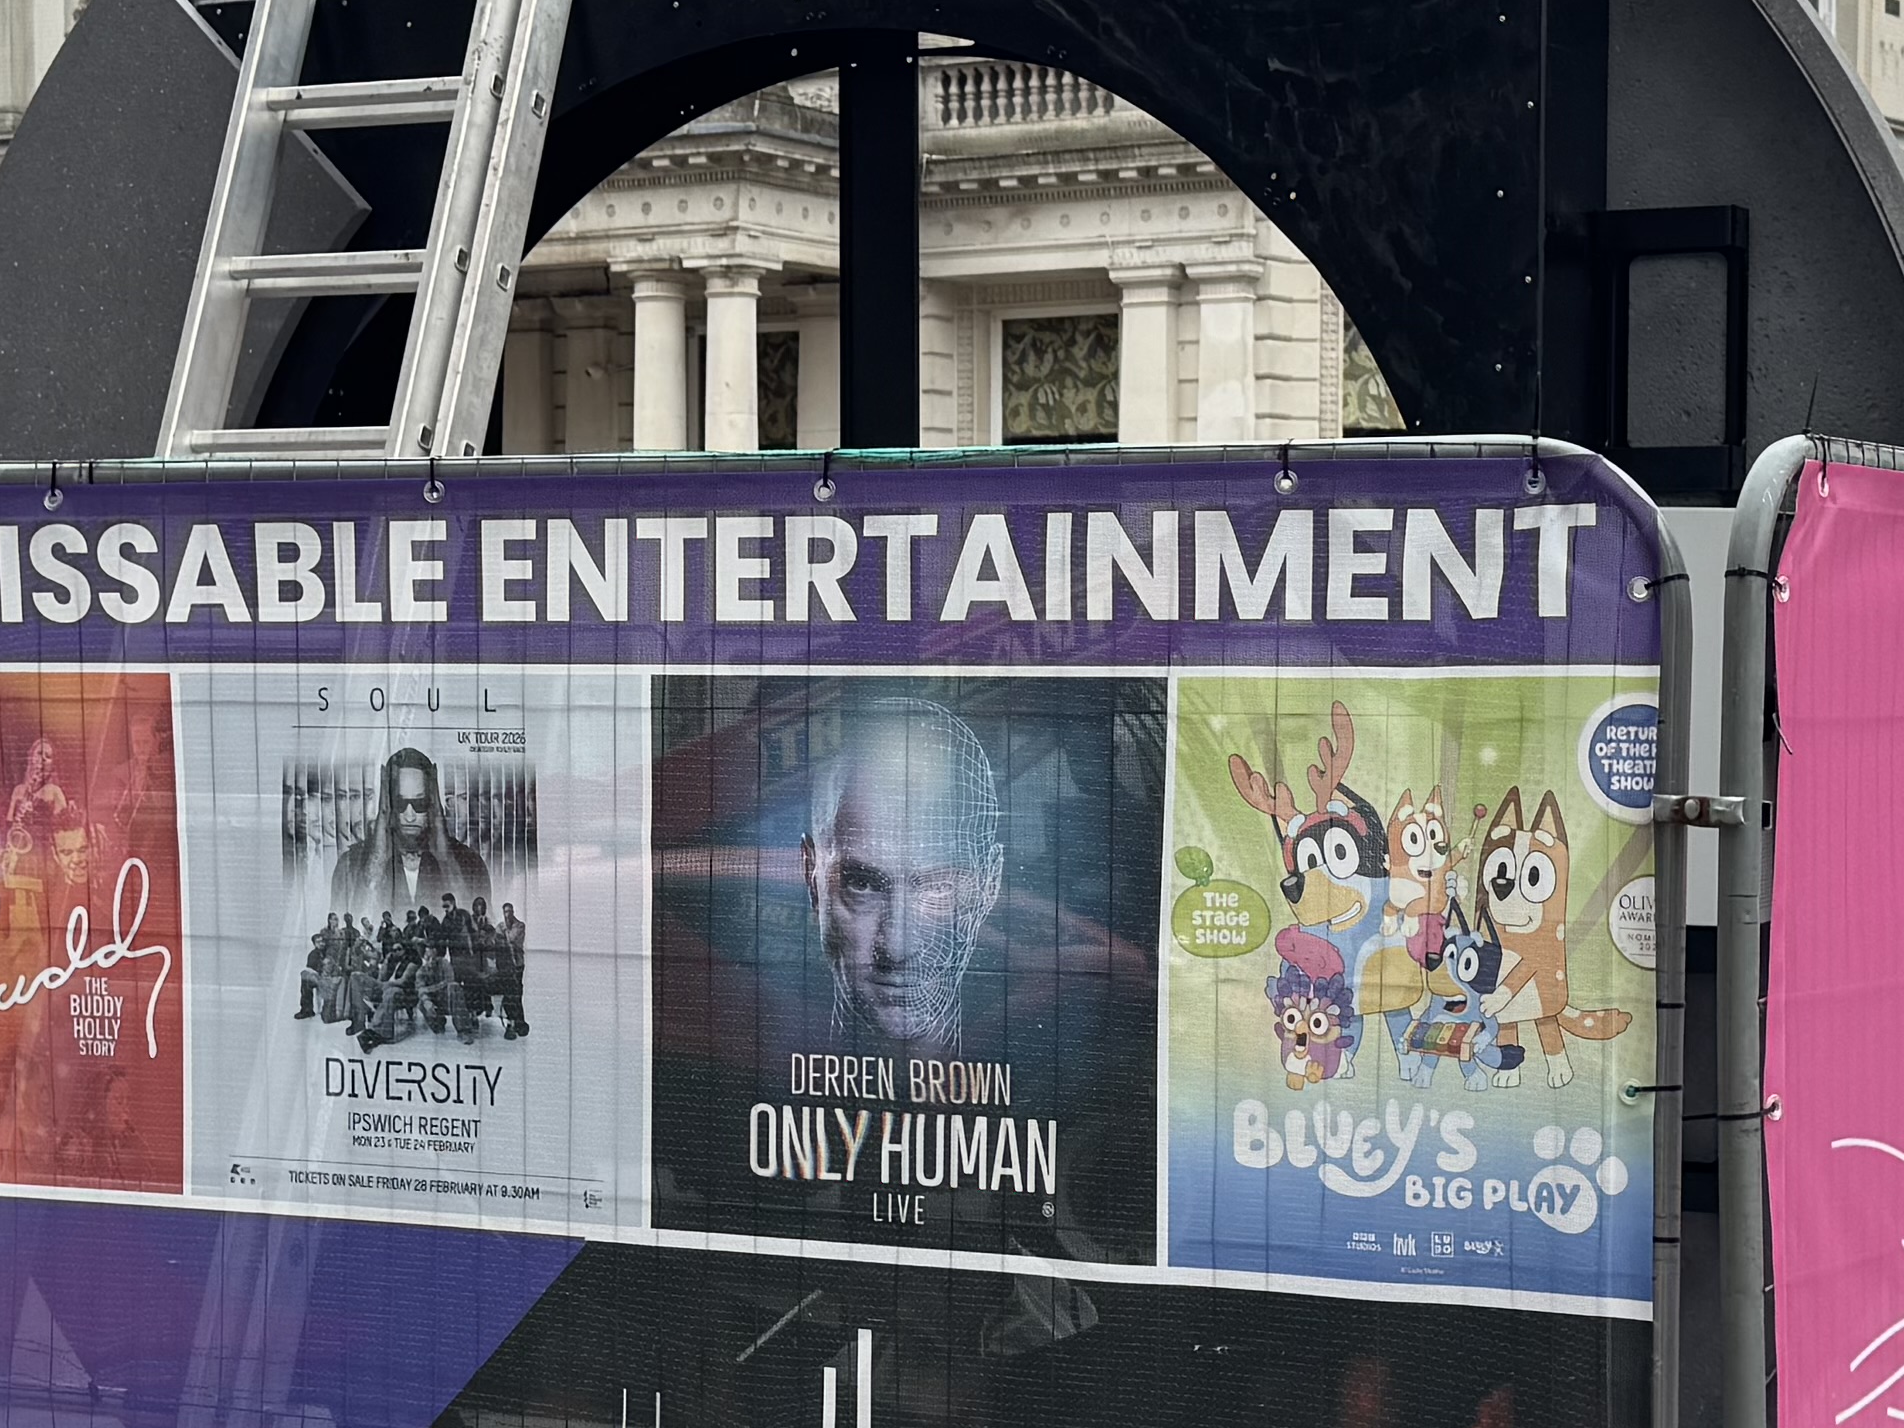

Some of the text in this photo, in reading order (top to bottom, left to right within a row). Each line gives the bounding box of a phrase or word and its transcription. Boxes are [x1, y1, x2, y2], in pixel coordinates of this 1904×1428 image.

[479, 500, 1598, 625] ENTERTAINMENT
[457, 731, 473, 745] UK
[474, 731, 499, 745] TOUR
[1595, 742, 1617, 757] OF
[1610, 776, 1655, 791] SHOW
[1195, 928, 1247, 945] SHOW
[83, 975, 110, 997] THE
[69, 995, 124, 1019] BUDDY
[73, 1017, 121, 1041] HOLLY
[79, 1039, 117, 1058] STORY
[325, 1056, 504, 1107] DIVERSITY
[790, 1052, 1012, 1107] DERREN BROWN
[346, 1111, 481, 1139] IPSWICH REGENT
[352, 1135, 373, 1149] MON
[374, 1137, 386, 1149] 23
[394, 1137, 412, 1151] TUE
[413, 1139, 427, 1151] 24
[427, 1140, 477, 1155] FEBRUARY
[749, 1102, 1058, 1196] ONLY HUMAN
[287, 1169, 331, 1187] TICKETS
[331, 1171, 348, 1187] ON
[348, 1172, 375, 1190] SALE
[375, 1174, 413, 1193] FRIDAY
[413, 1176, 428, 1192] 28
[429, 1177, 484, 1198] FEBRUARY
[484, 1180, 499, 1198] AT
[1404, 1174, 1581, 1217] BIG PLAY
[872, 1191, 926, 1226] LIVE
